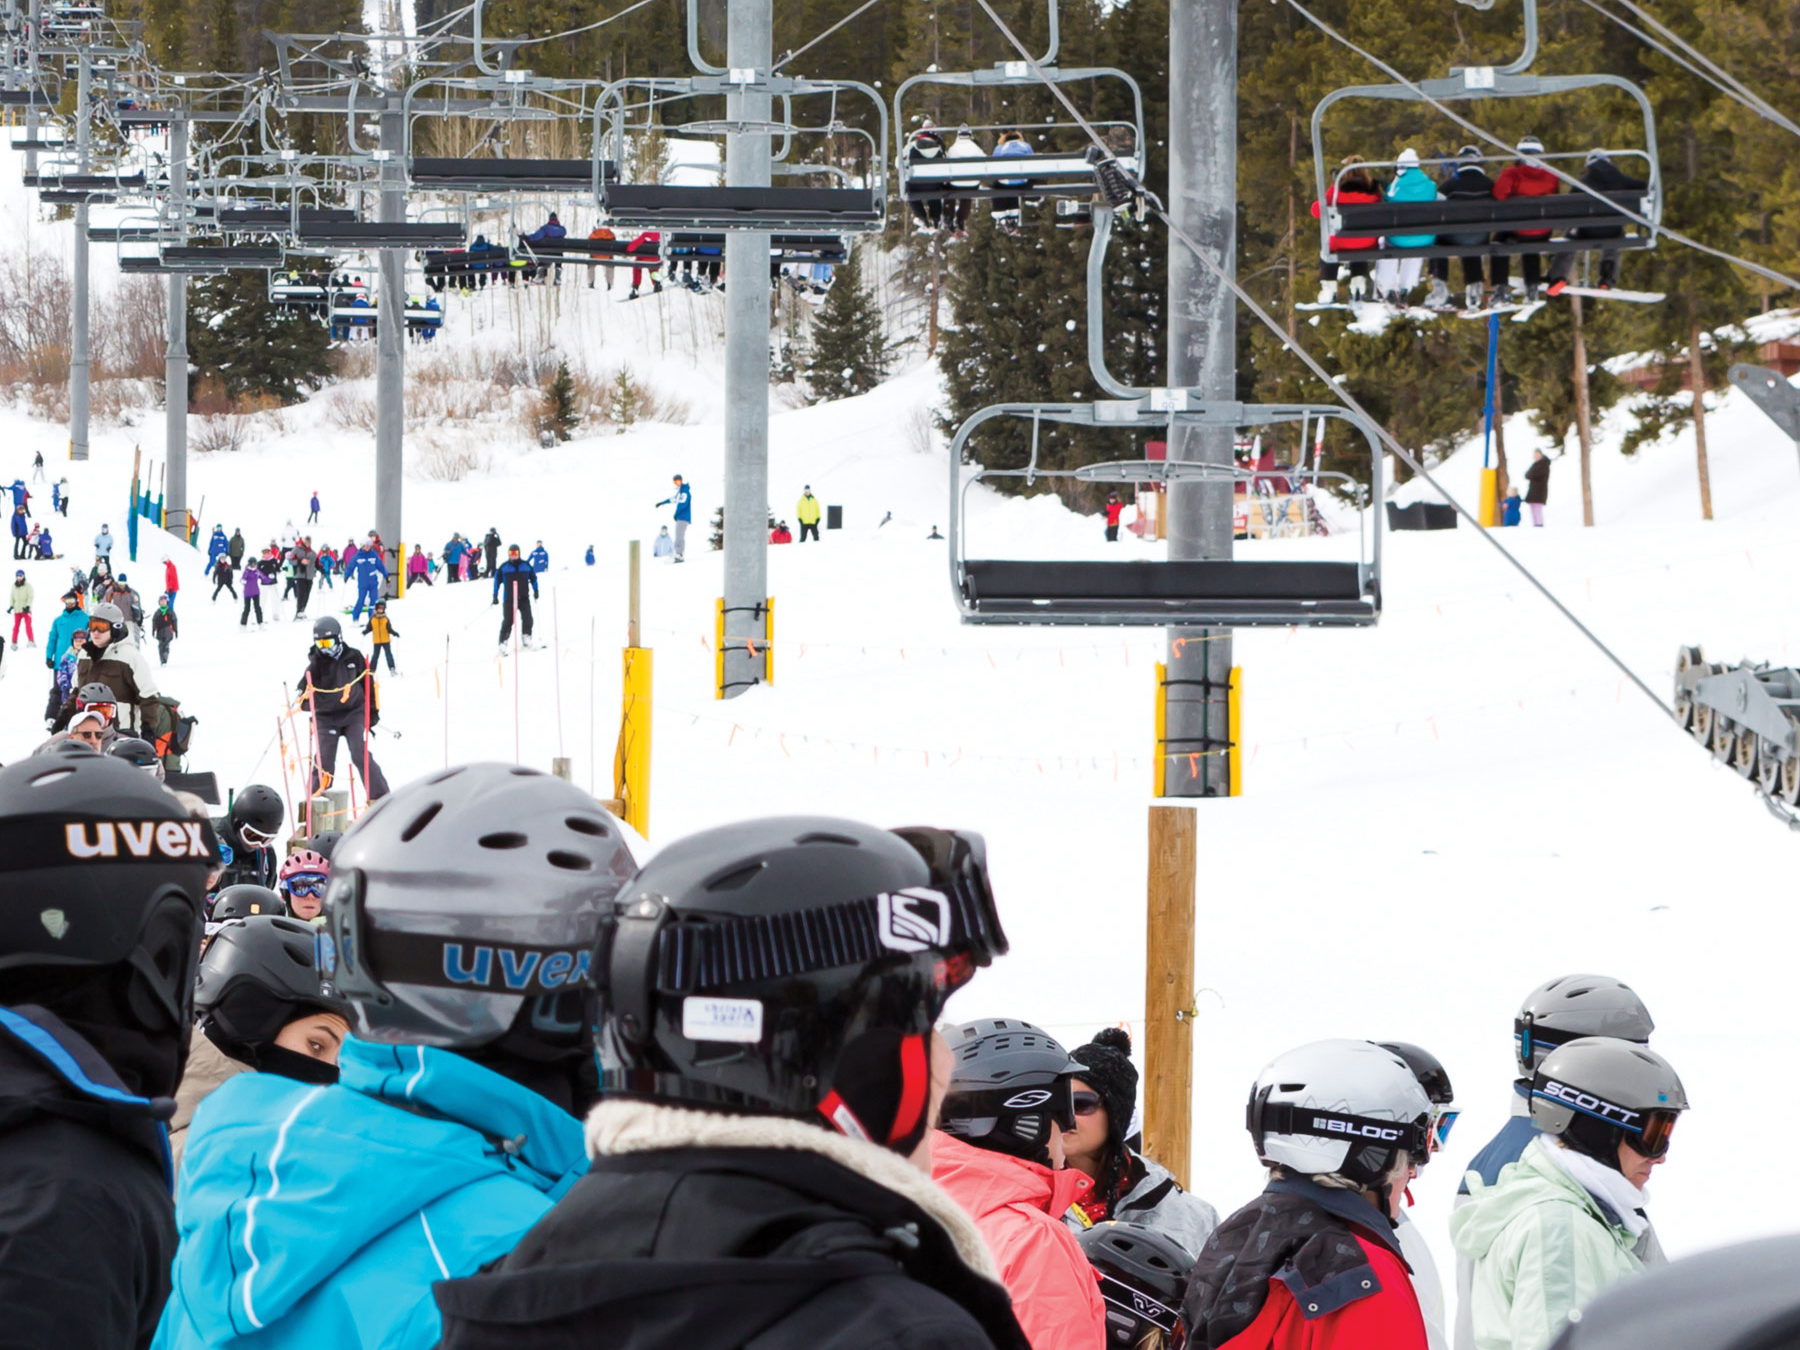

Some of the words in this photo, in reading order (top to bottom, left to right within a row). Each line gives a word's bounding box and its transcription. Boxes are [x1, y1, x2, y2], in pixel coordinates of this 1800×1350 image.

[65, 820, 210, 859] uvex
[442, 942, 593, 990] uvex
[1543, 1080, 1641, 1123] SCOTT
[1327, 1119, 1398, 1141] BLOC
